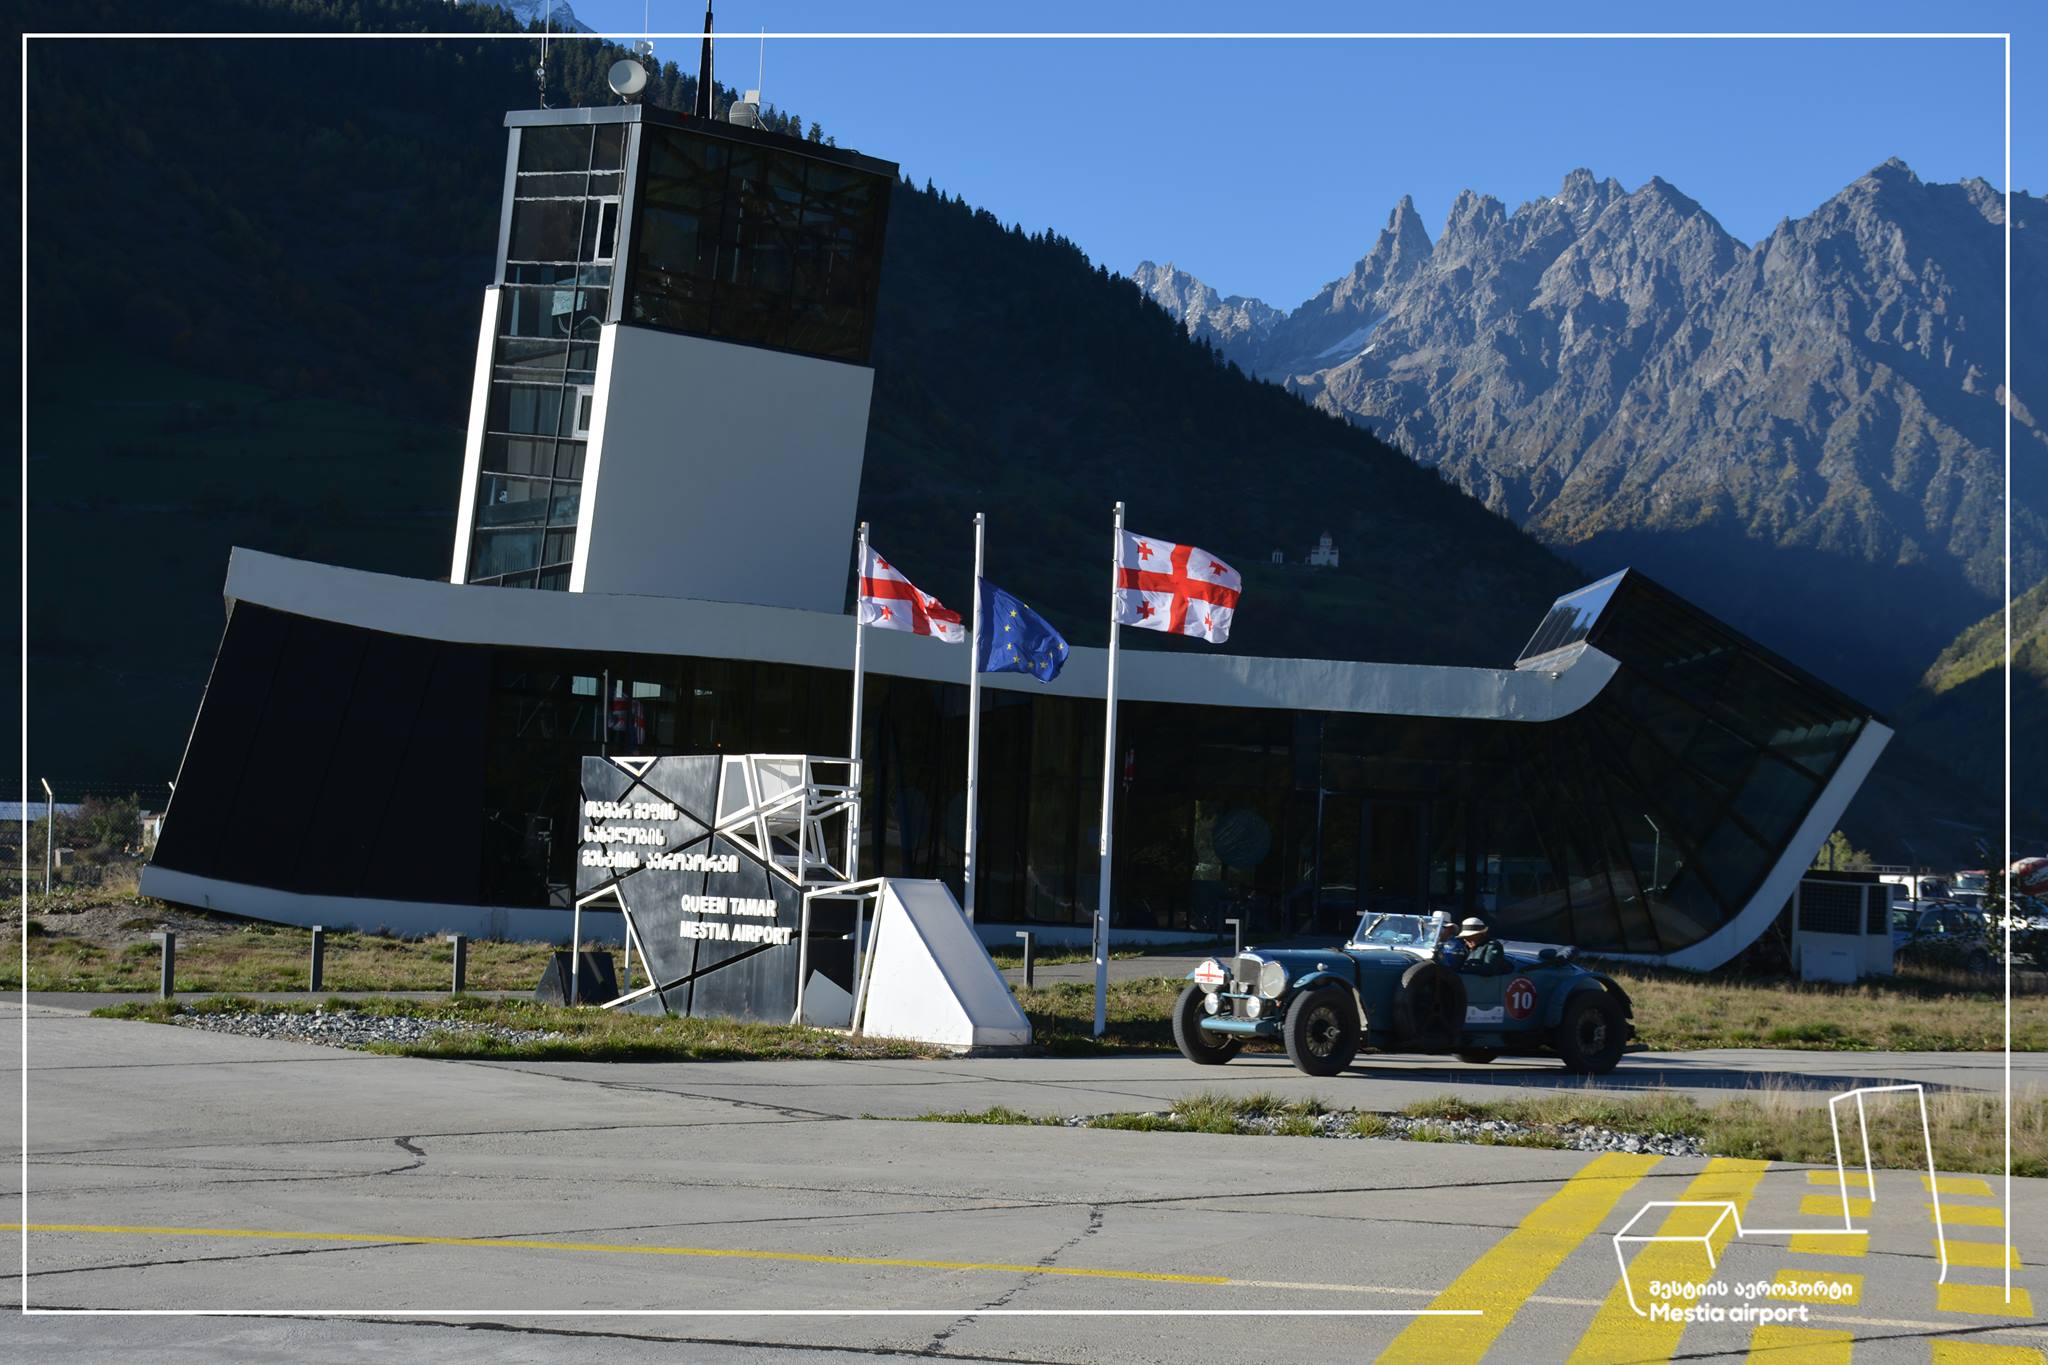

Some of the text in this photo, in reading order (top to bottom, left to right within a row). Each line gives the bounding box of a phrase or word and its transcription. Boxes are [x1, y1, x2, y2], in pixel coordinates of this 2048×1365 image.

[585, 801, 679, 821] თამარ მეფის
[583, 825, 666, 846] სახელობის
[582, 849, 740, 873] მესტიის აეროპორტი
[681, 894, 778, 918] QUEEN TAMAR
[679, 920, 793, 945] MESTIA AIRPORT
[1511, 991, 1533, 1010] 10
